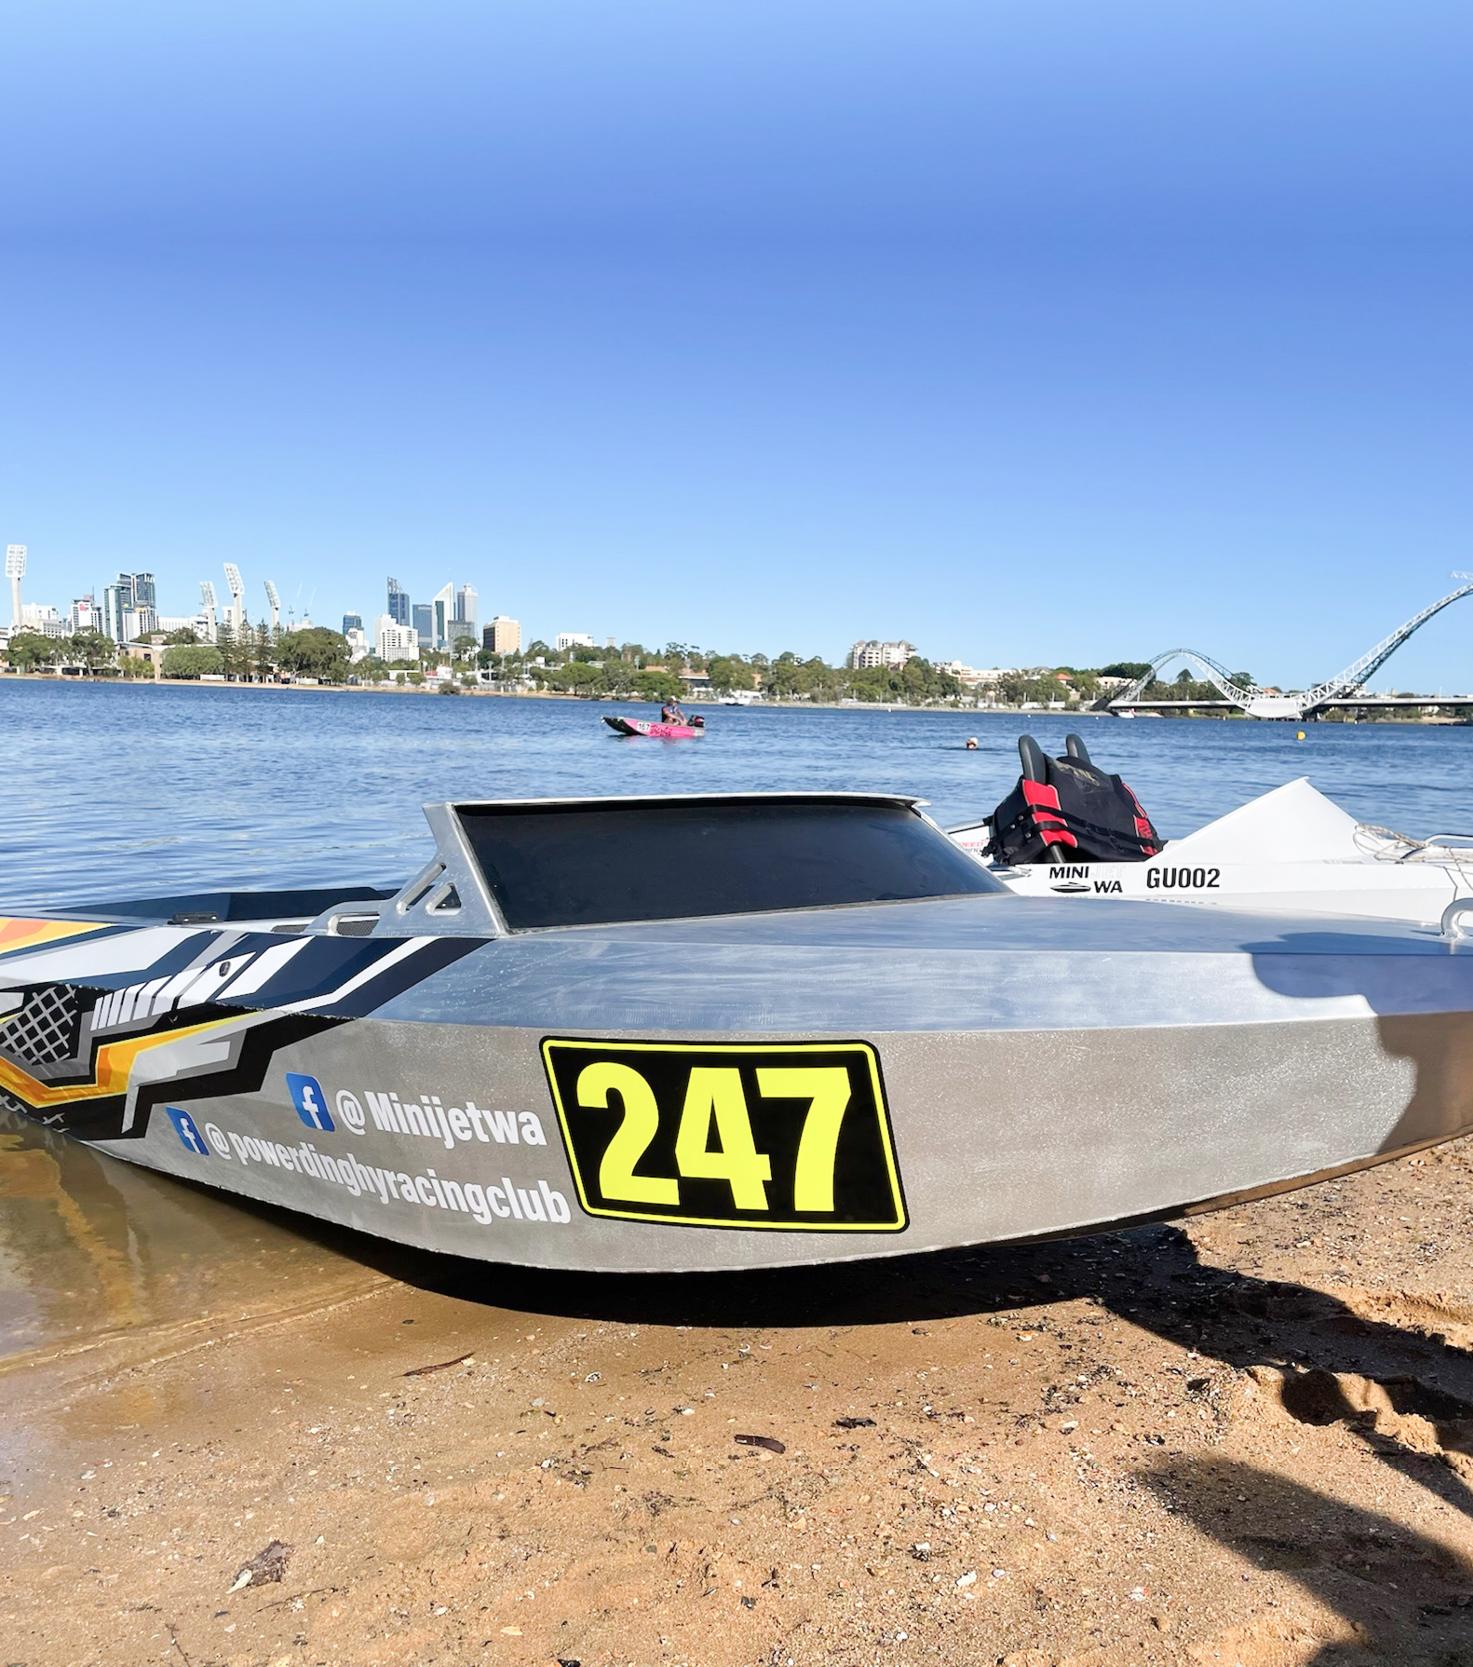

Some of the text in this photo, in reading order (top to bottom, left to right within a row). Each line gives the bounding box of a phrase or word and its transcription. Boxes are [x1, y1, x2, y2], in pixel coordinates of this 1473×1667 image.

[1049, 866, 1090, 879] MINI
[1146, 867, 1221, 889] GU002
[1093, 880, 1123, 894] WA
[576, 1061, 852, 1212] 247
